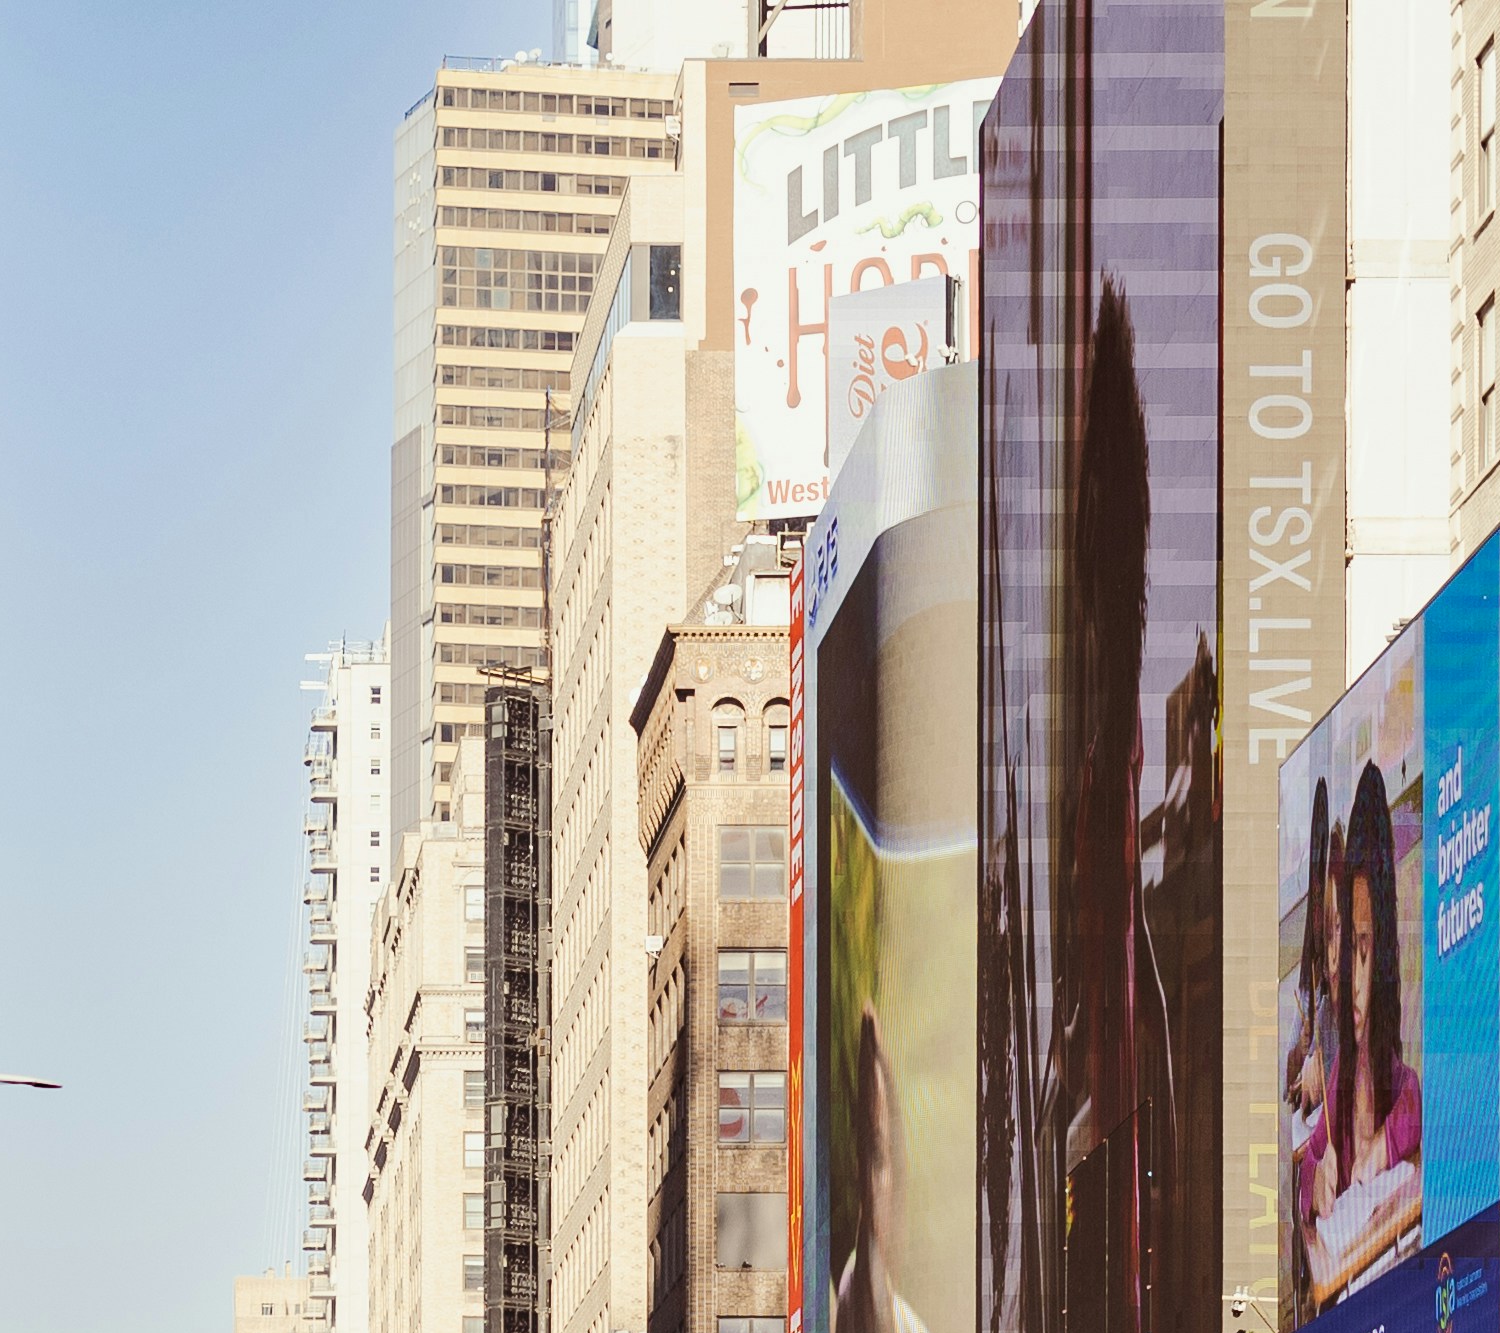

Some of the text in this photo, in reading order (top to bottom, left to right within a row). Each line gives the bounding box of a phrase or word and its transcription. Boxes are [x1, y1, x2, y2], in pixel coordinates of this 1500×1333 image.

[787, 100, 980, 246] LITTL
[1248, 232, 1313, 766] GO TO TSX.LIVE
[1437, 745, 1463, 815] and
[1437, 803, 1492, 888] brighter
[1437, 899, 1485, 960] futures
